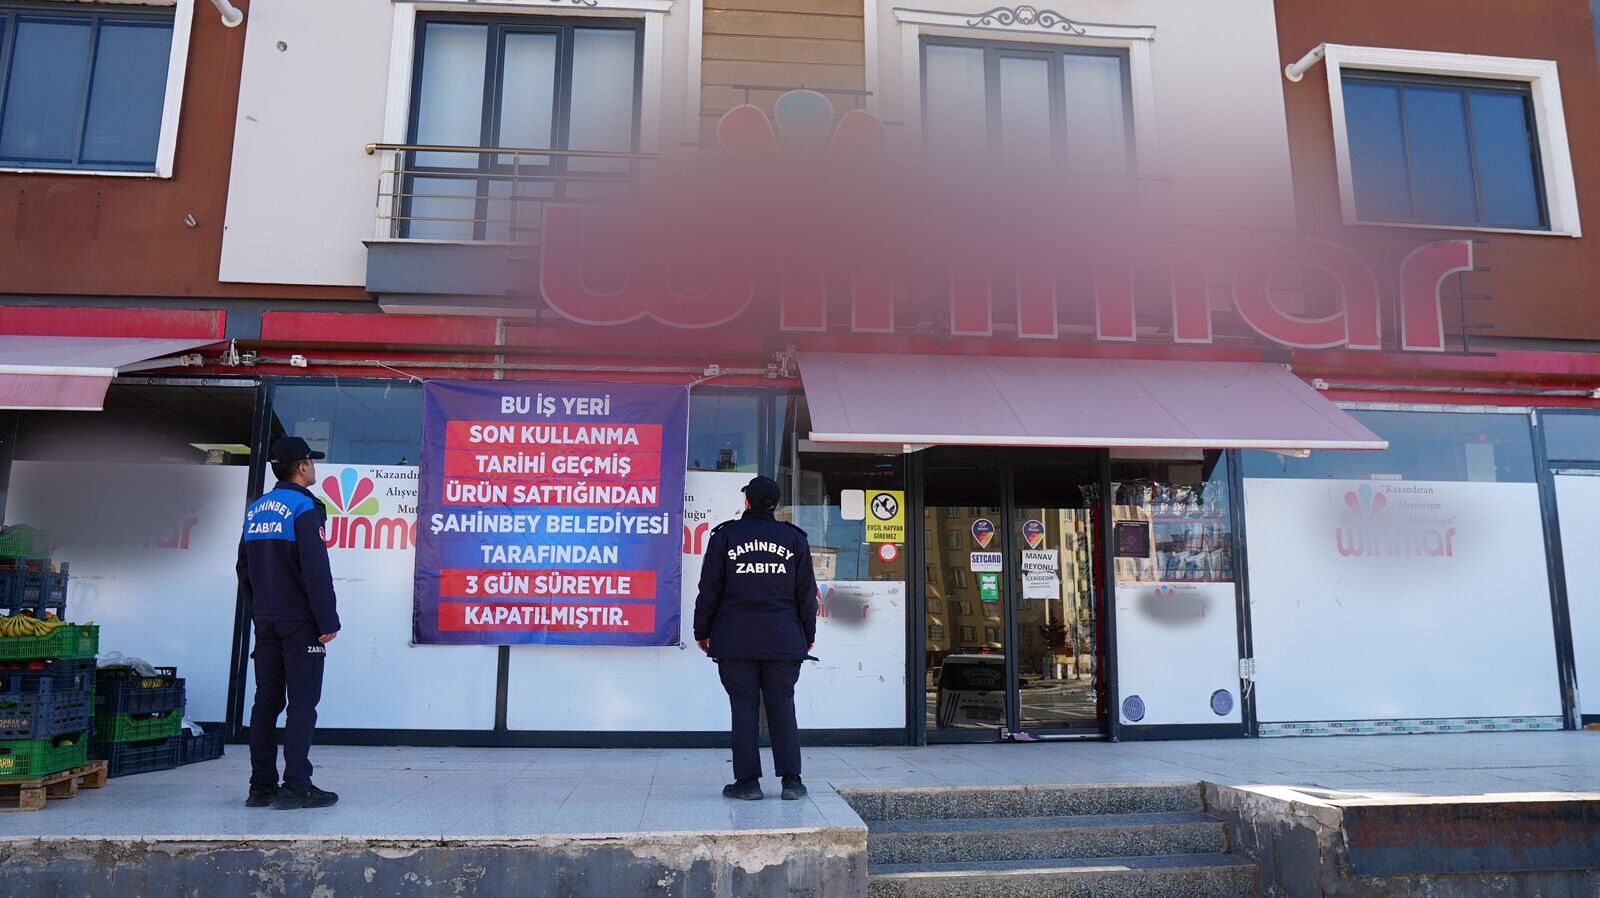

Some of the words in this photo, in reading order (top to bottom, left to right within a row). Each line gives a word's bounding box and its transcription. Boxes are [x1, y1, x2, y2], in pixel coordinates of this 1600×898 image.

[501, 396, 530, 414] BU
[536, 393, 556, 417] İŞ
[561, 395, 610, 416] YERİ
[469, 425, 515, 444] SON
[521, 426, 640, 446] KULLANMA
[475, 451, 546, 474] TARİHİ
[551, 453, 632, 477] GEÇMİŞ
[446, 480, 507, 503] ÜRÜN
[513, 481, 657, 505] SATTIĞINDAN
[430, 510, 542, 536] ŞAHİNBEY
[546, 511, 669, 535] BELEDİYESİ
[480, 545, 618, 564] TARAFINDAN
[727, 539, 795, 561] ŞAHİNBEY
[971, 554, 1001, 563] SETCARD
[735, 562, 787, 574] ZABITA
[1023, 563, 1054, 571] REYONU
[465, 576, 478, 594] 3
[484, 572, 529, 594] GÜN
[534, 571, 631, 595] SÜREYLE
[464, 606, 629, 629] KAPATILMIŞTIR.
